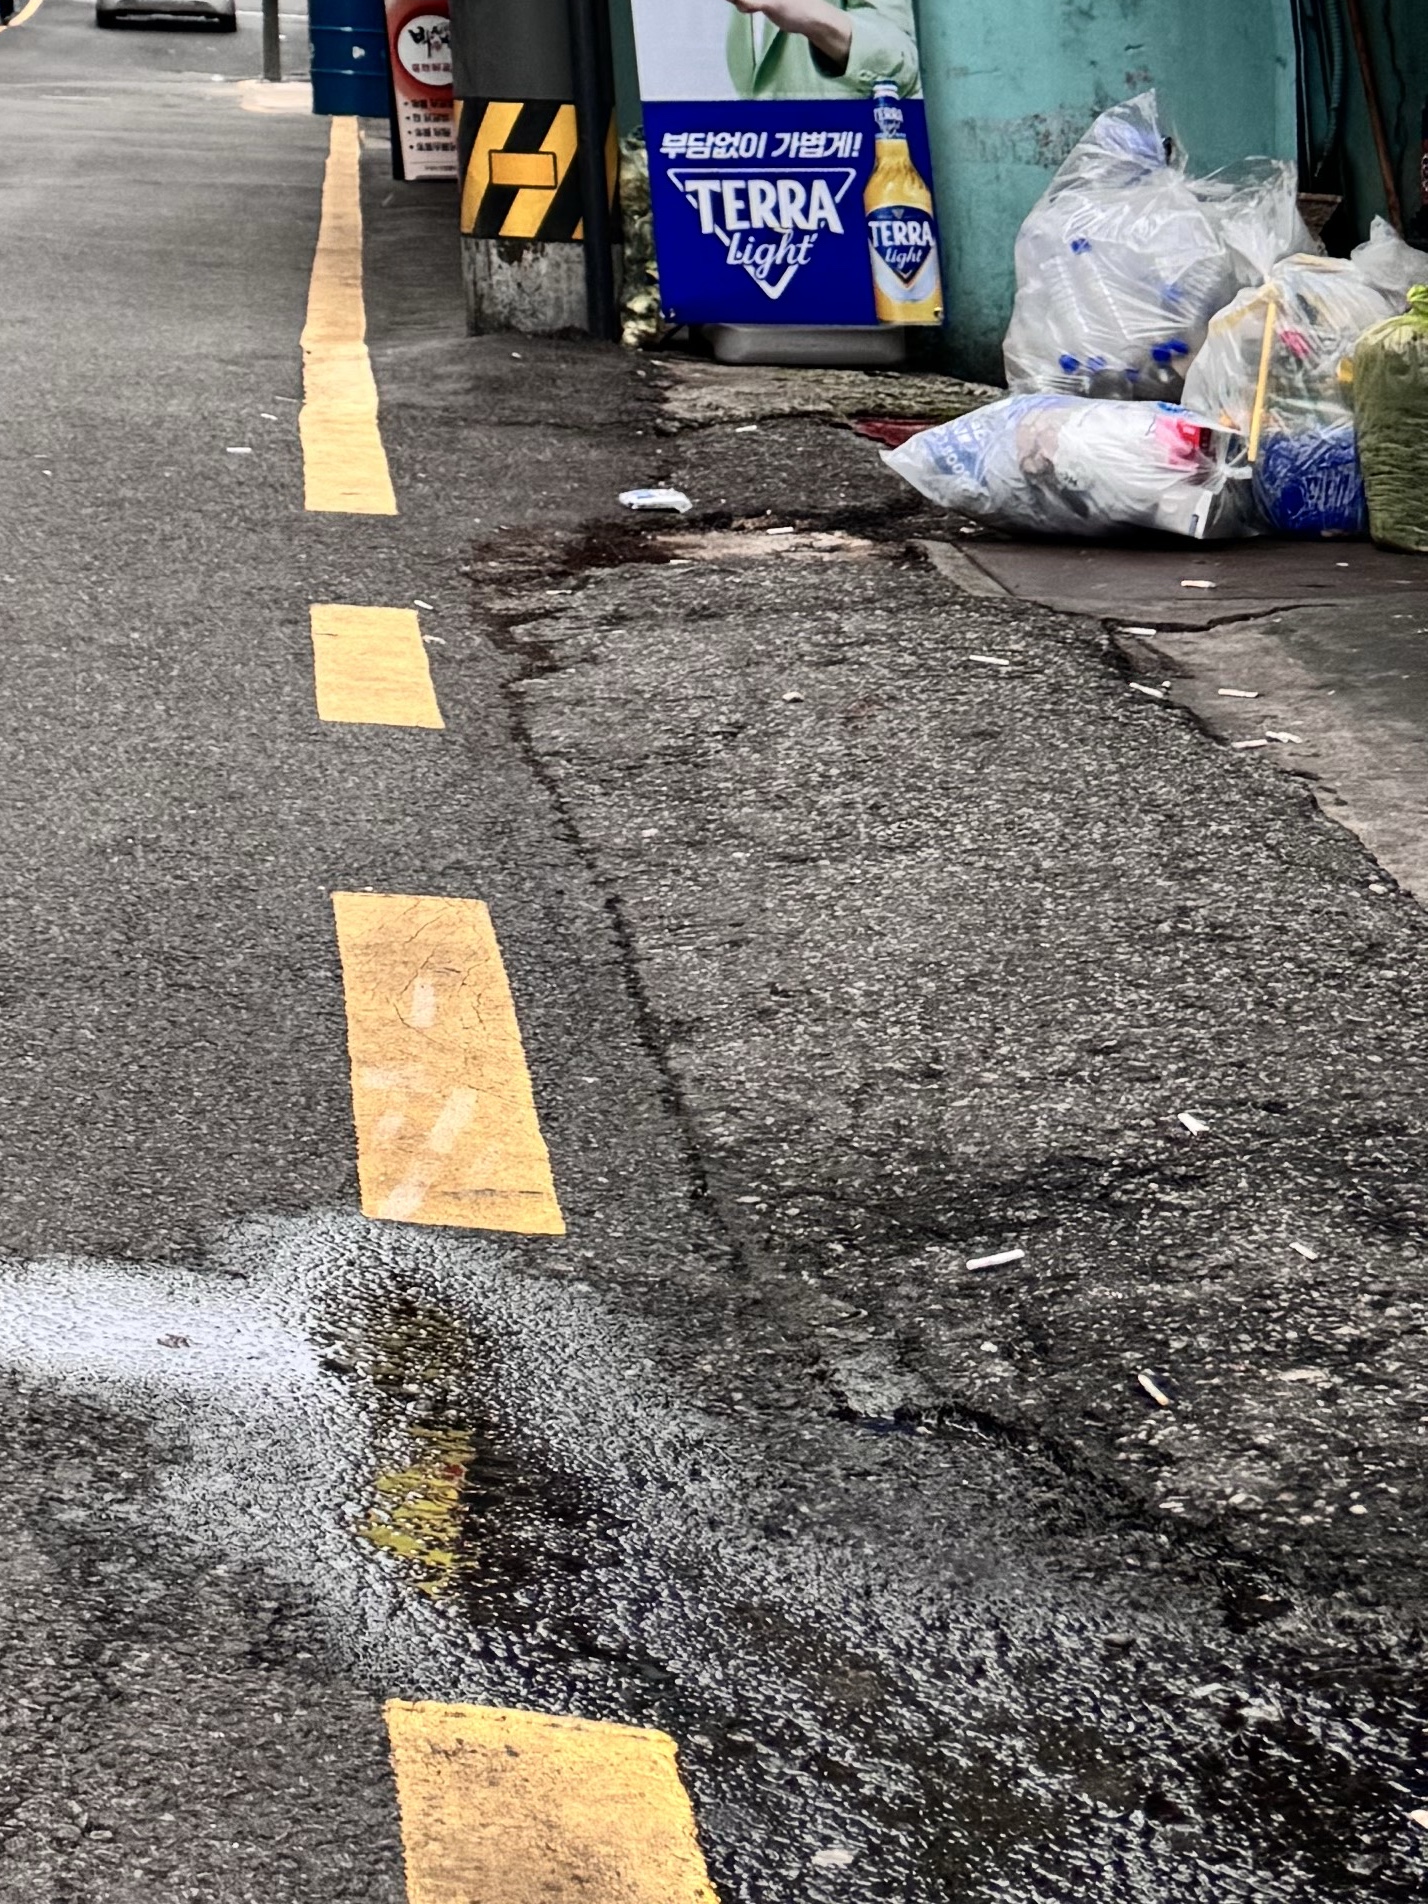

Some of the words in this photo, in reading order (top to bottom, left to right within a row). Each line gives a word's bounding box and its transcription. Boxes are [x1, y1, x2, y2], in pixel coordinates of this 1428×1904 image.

[660, 131, 766, 160] 부담없이
[772, 130, 864, 160] 가볍게!
[684, 178, 845, 235] TERRA
[725, 227, 817, 281] Light
[867, 219, 936, 249] TERRA
